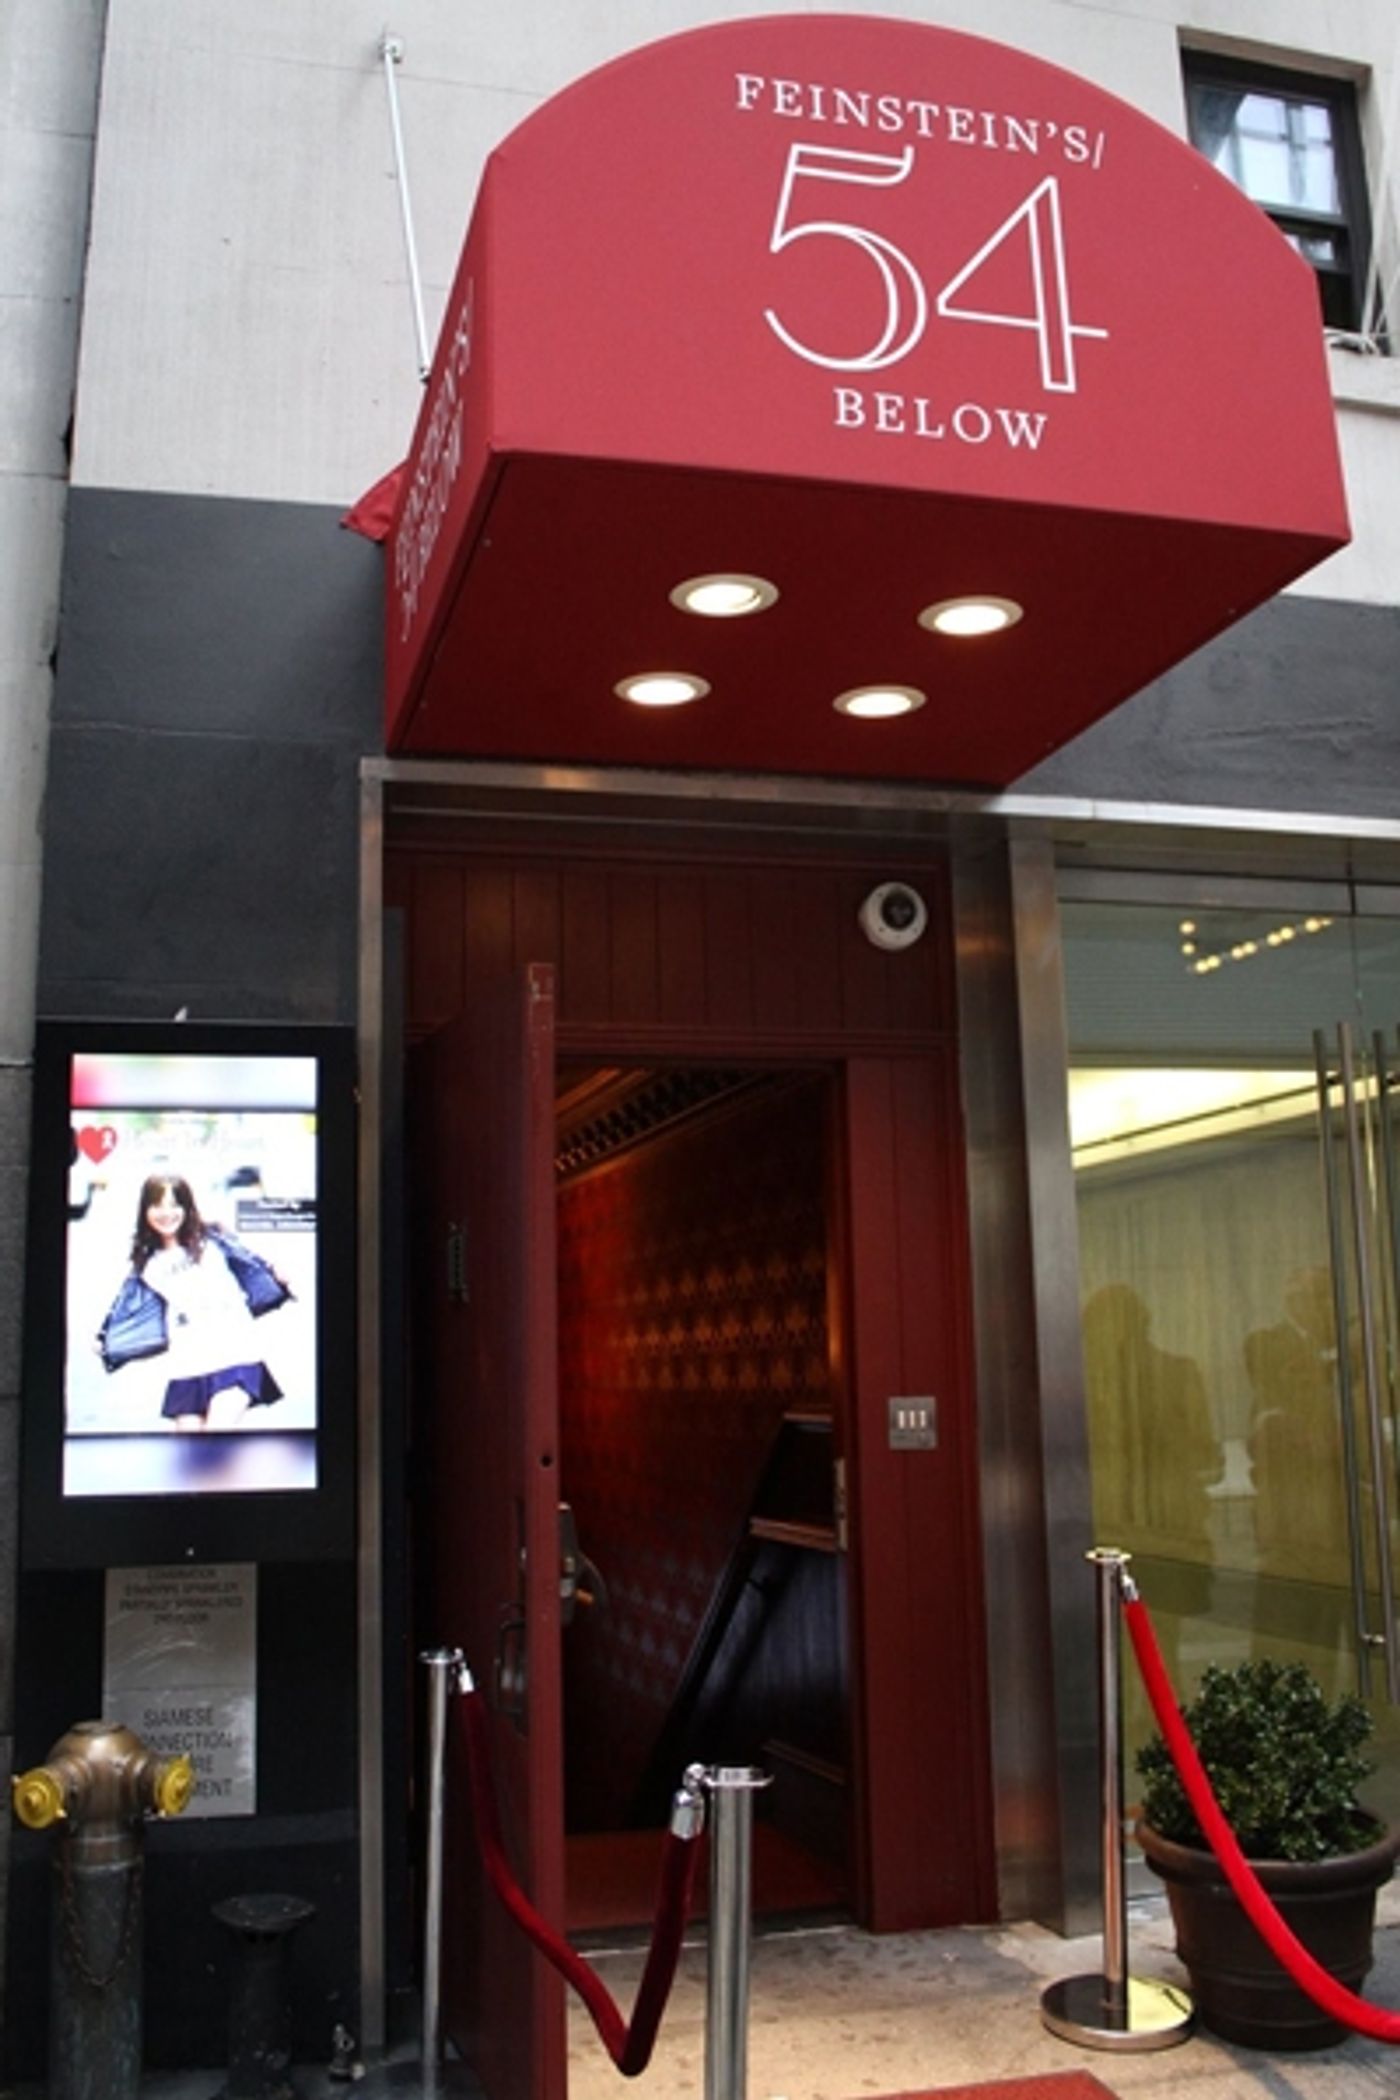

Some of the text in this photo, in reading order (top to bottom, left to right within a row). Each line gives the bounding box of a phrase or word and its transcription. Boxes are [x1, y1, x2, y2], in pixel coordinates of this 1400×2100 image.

[735, 72, 1104, 169] FEINSTEIN'S/
[765, 142, 1109, 393] 54
[833, 386, 1048, 450] BELOW
